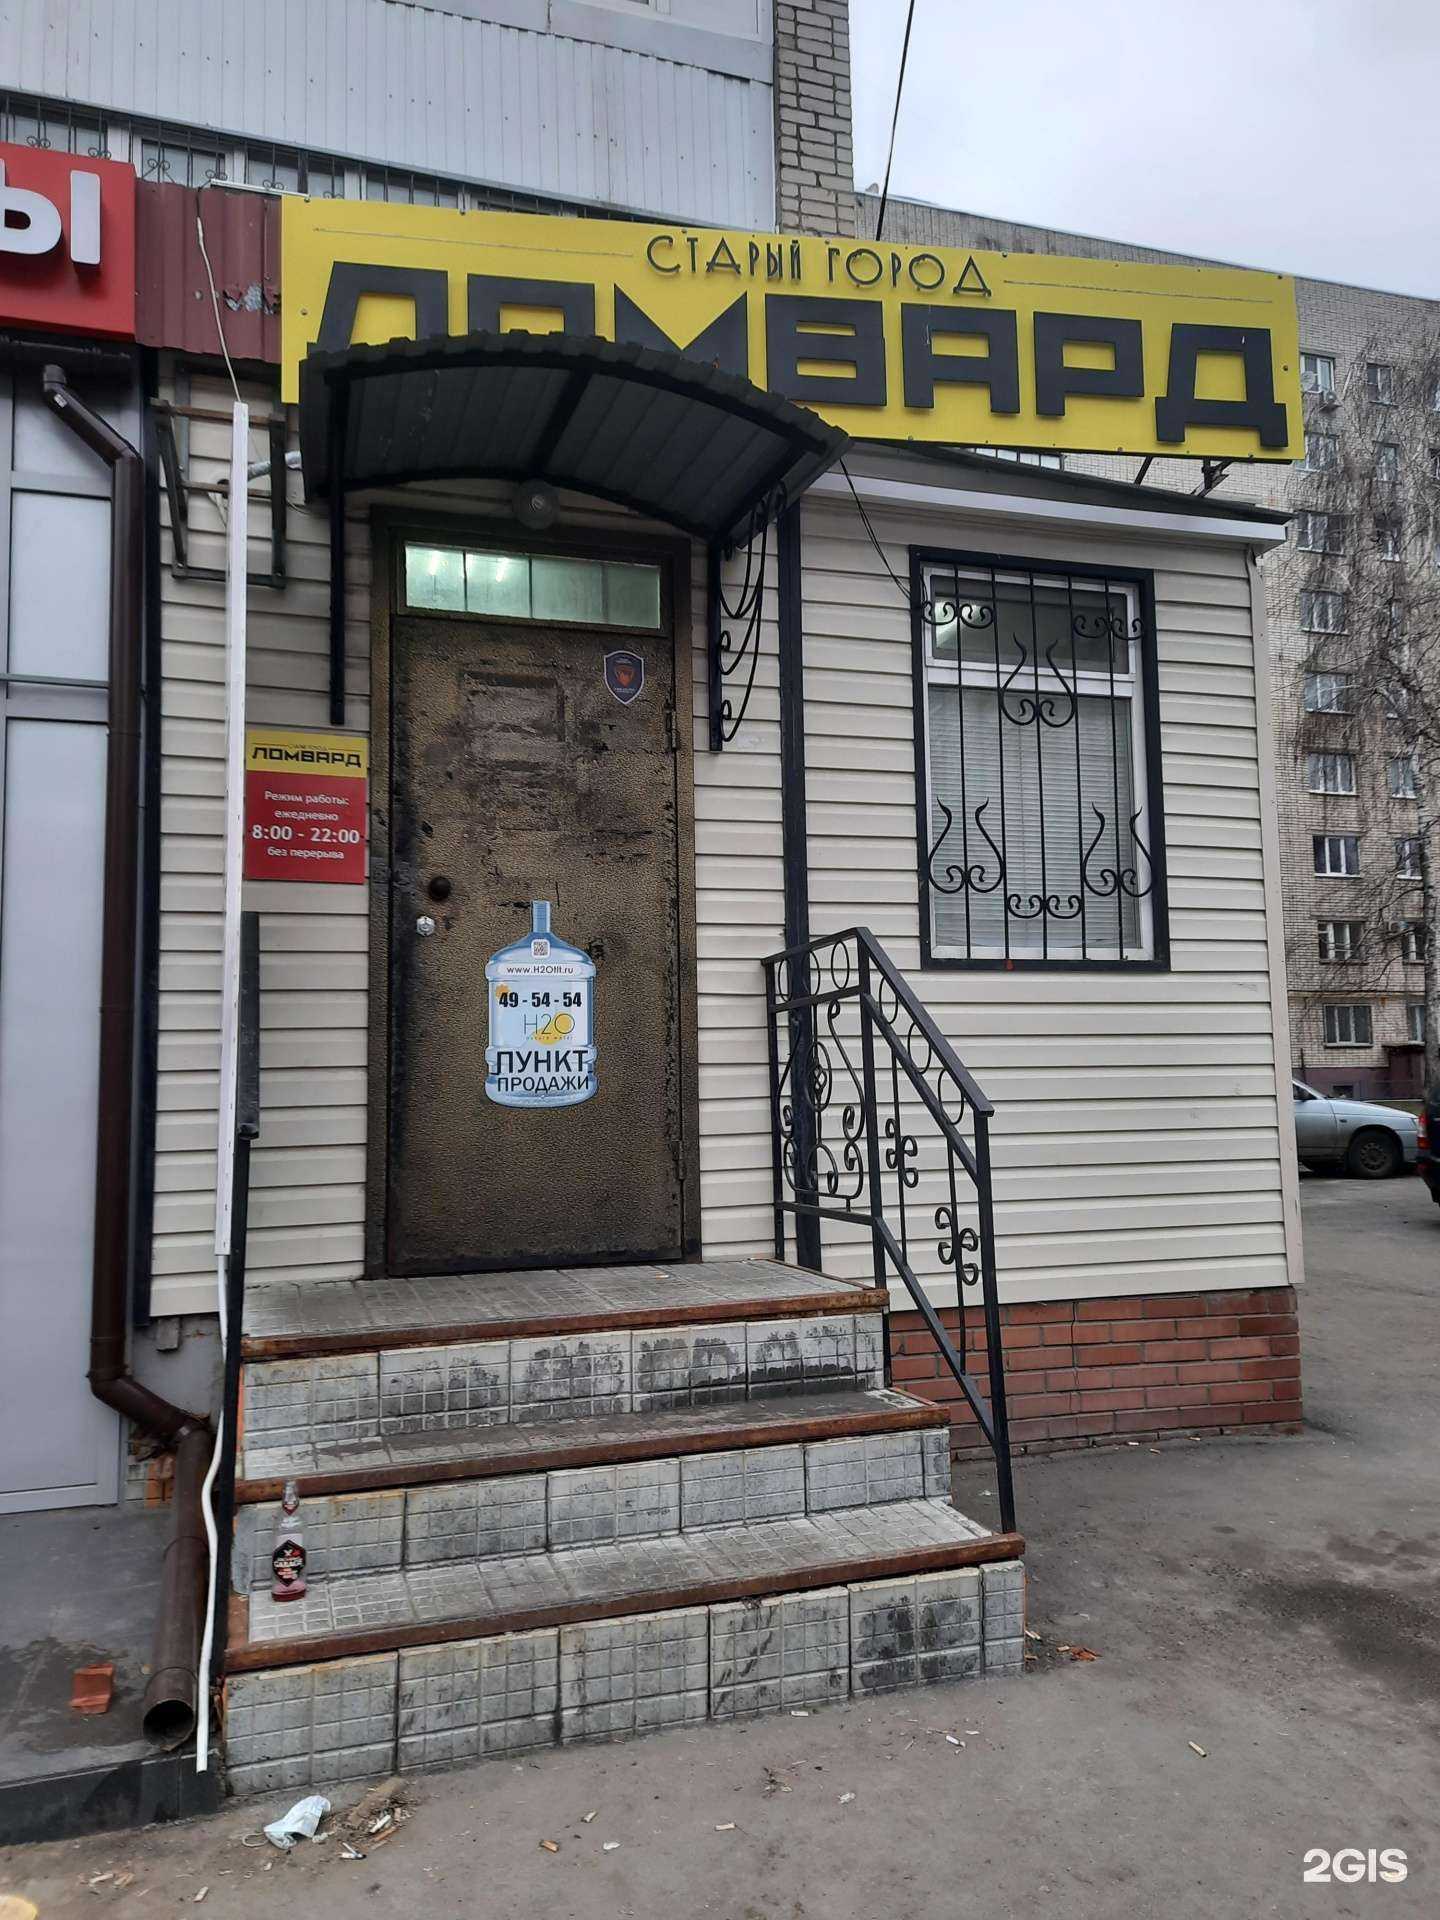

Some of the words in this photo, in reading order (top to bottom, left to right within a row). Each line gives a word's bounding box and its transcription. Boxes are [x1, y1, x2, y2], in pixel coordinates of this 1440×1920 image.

[647, 234, 801, 281] СТАРЫЙ
[828, 246, 992, 297] ГОРОД
[264, 791, 303, 802] Режим
[305, 795, 350, 805] работы:
[274, 810, 339, 821] ежедневно
[252, 824, 293, 841] 8:00
[310, 827, 360, 844] 22:00
[267, 846, 288, 857] без
[290, 850, 345, 860] перерыва
[499, 991, 519, 1008] 49
[531, 991, 551, 1008] 54
[562, 991, 582, 1008] 54
[523, 1013, 576, 1035] H2O
[496, 1050, 588, 1074] ПУНКТ
[497, 1076, 589, 1093] ПРОДАЖИ
